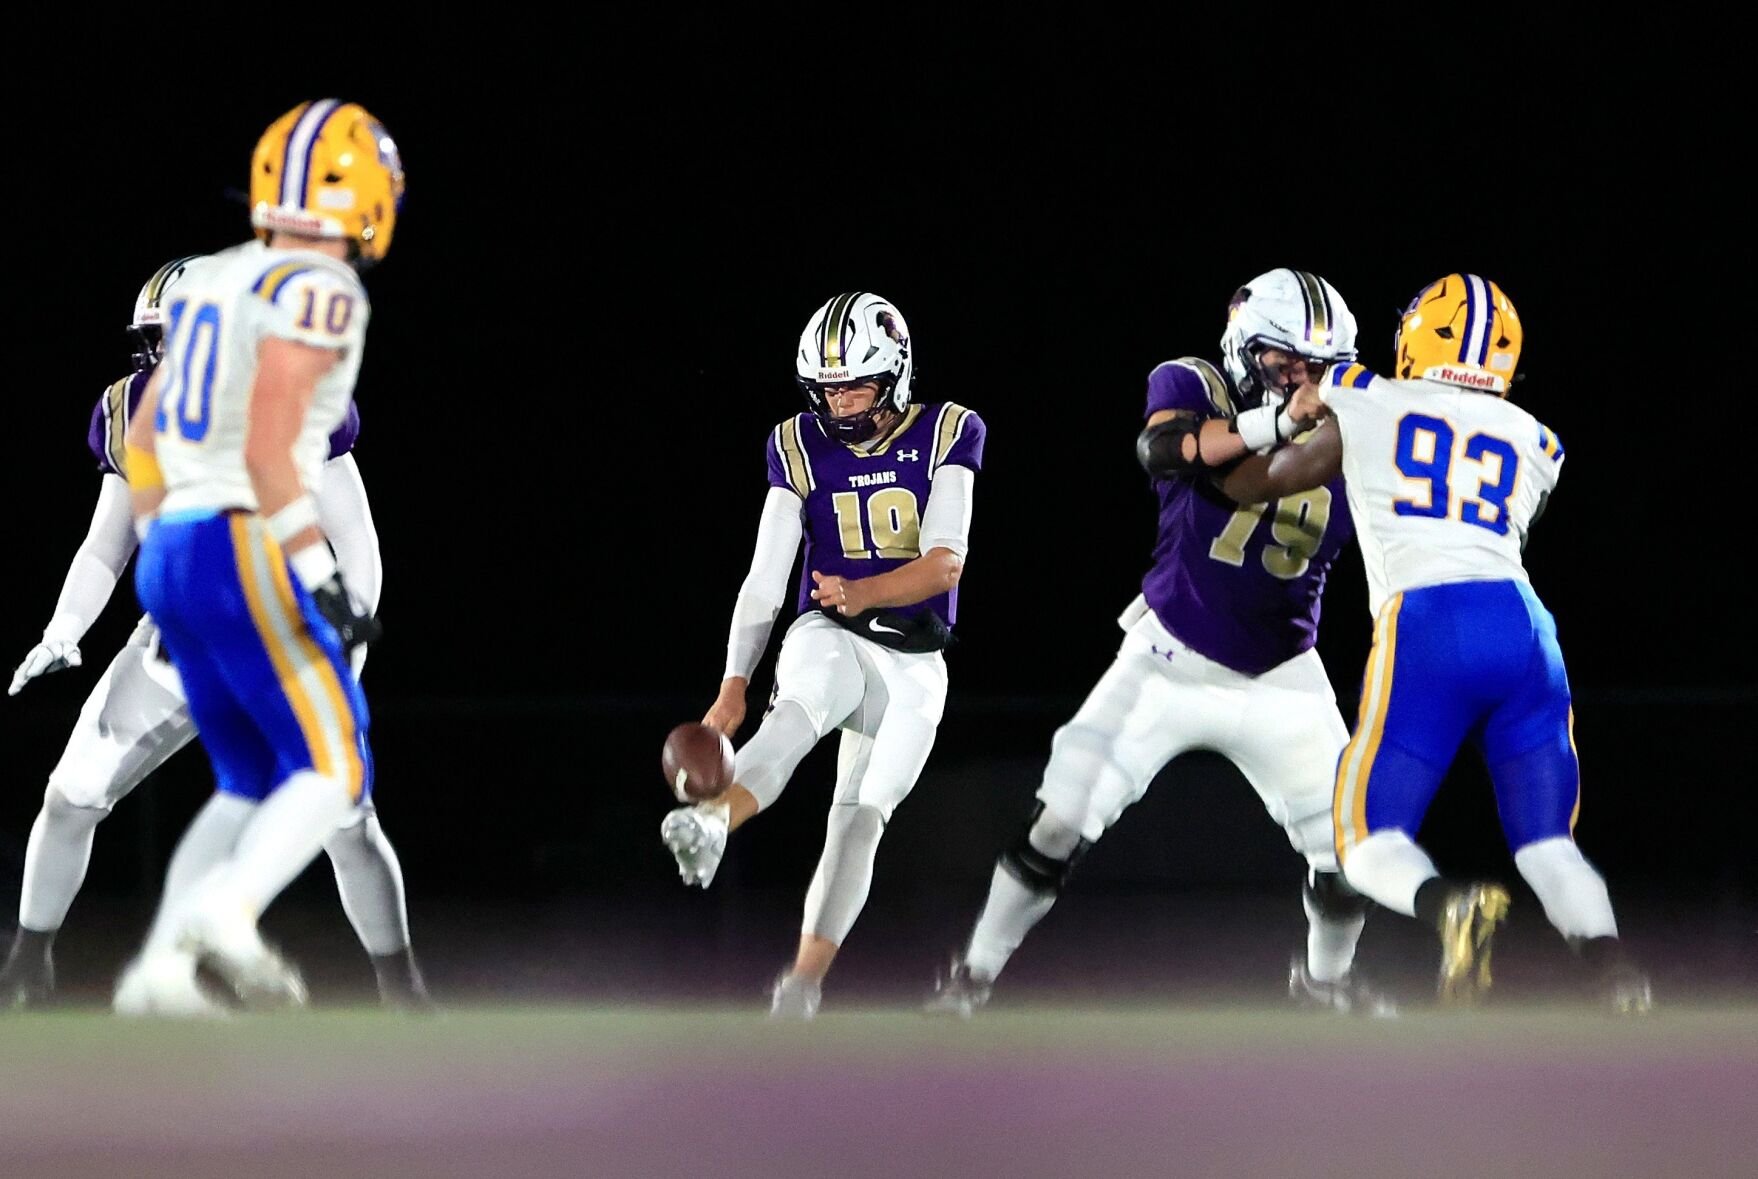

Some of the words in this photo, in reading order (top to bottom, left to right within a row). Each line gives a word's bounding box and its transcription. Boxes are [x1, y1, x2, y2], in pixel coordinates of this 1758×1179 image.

[299, 286, 354, 336] 10
[153, 297, 221, 443] 10
[818, 370, 850, 380] Riddell
[1441, 368, 1495, 387] Riddell
[848, 470, 897, 488] TROJANS
[1392, 411, 1519, 537] 93
